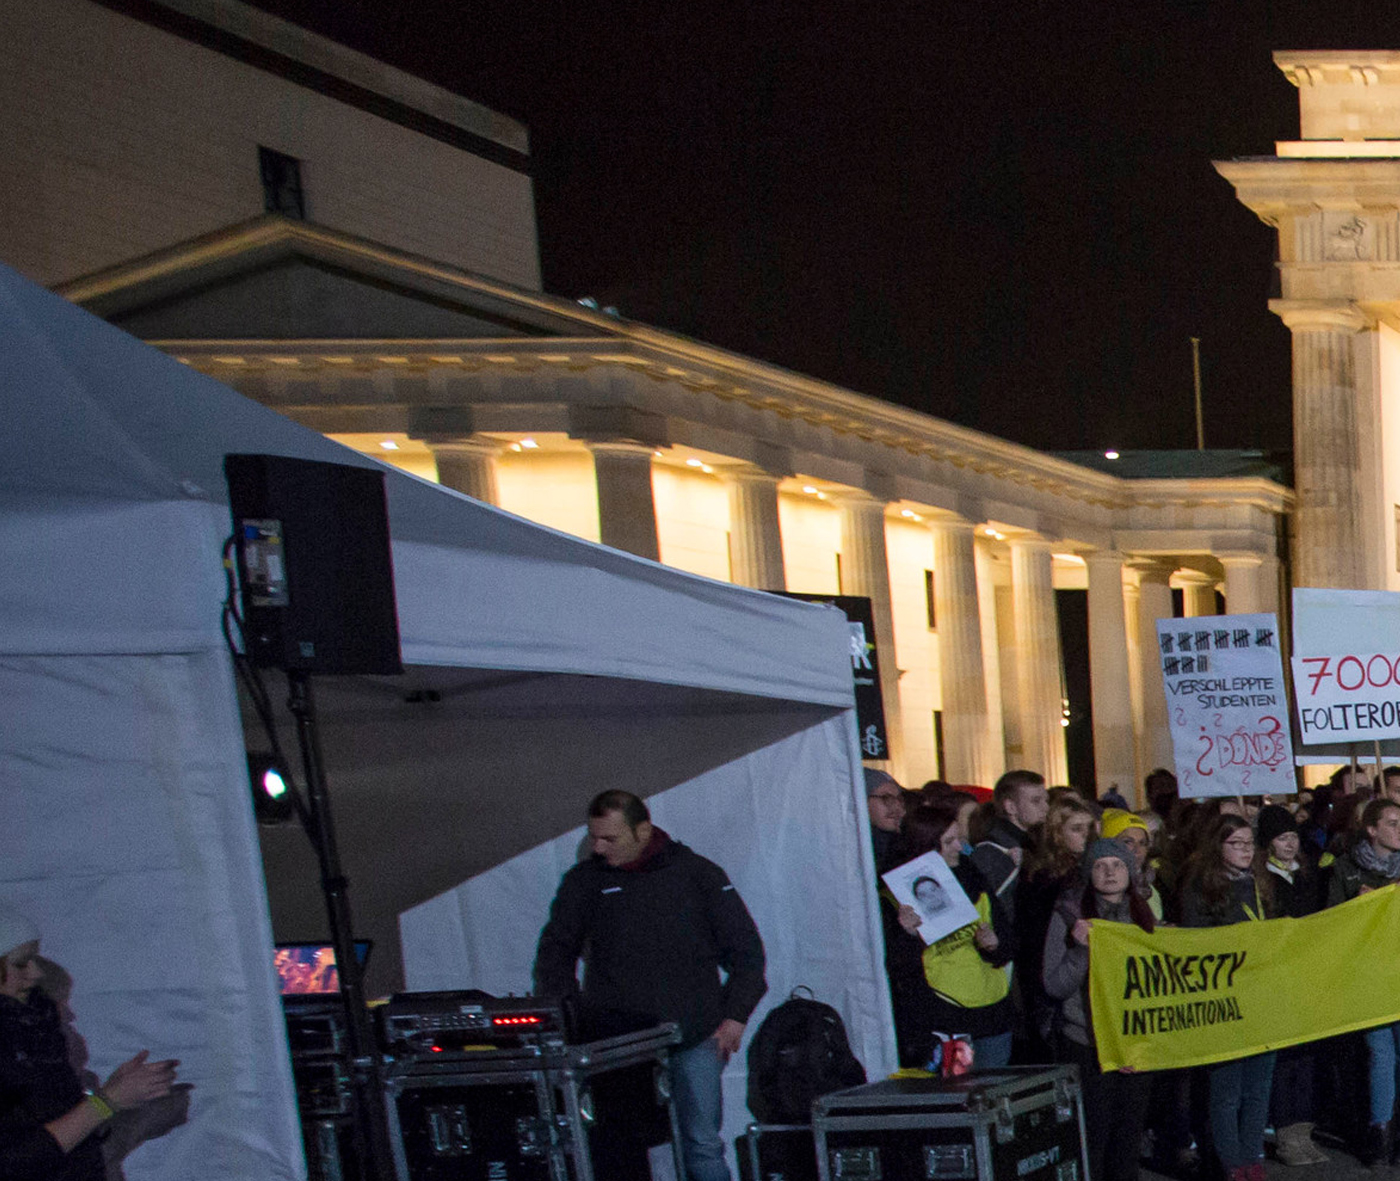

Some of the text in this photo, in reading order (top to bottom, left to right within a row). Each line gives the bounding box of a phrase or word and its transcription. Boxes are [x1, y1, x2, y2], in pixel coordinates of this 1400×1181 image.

[1167, 677, 1274, 696] VERSCHLEPPTE
[1197, 694, 1277, 709] STUDENTEN
[1123, 951, 1246, 1000] AMNESTY
[1122, 997, 1243, 1036] INTERNATIONAL
